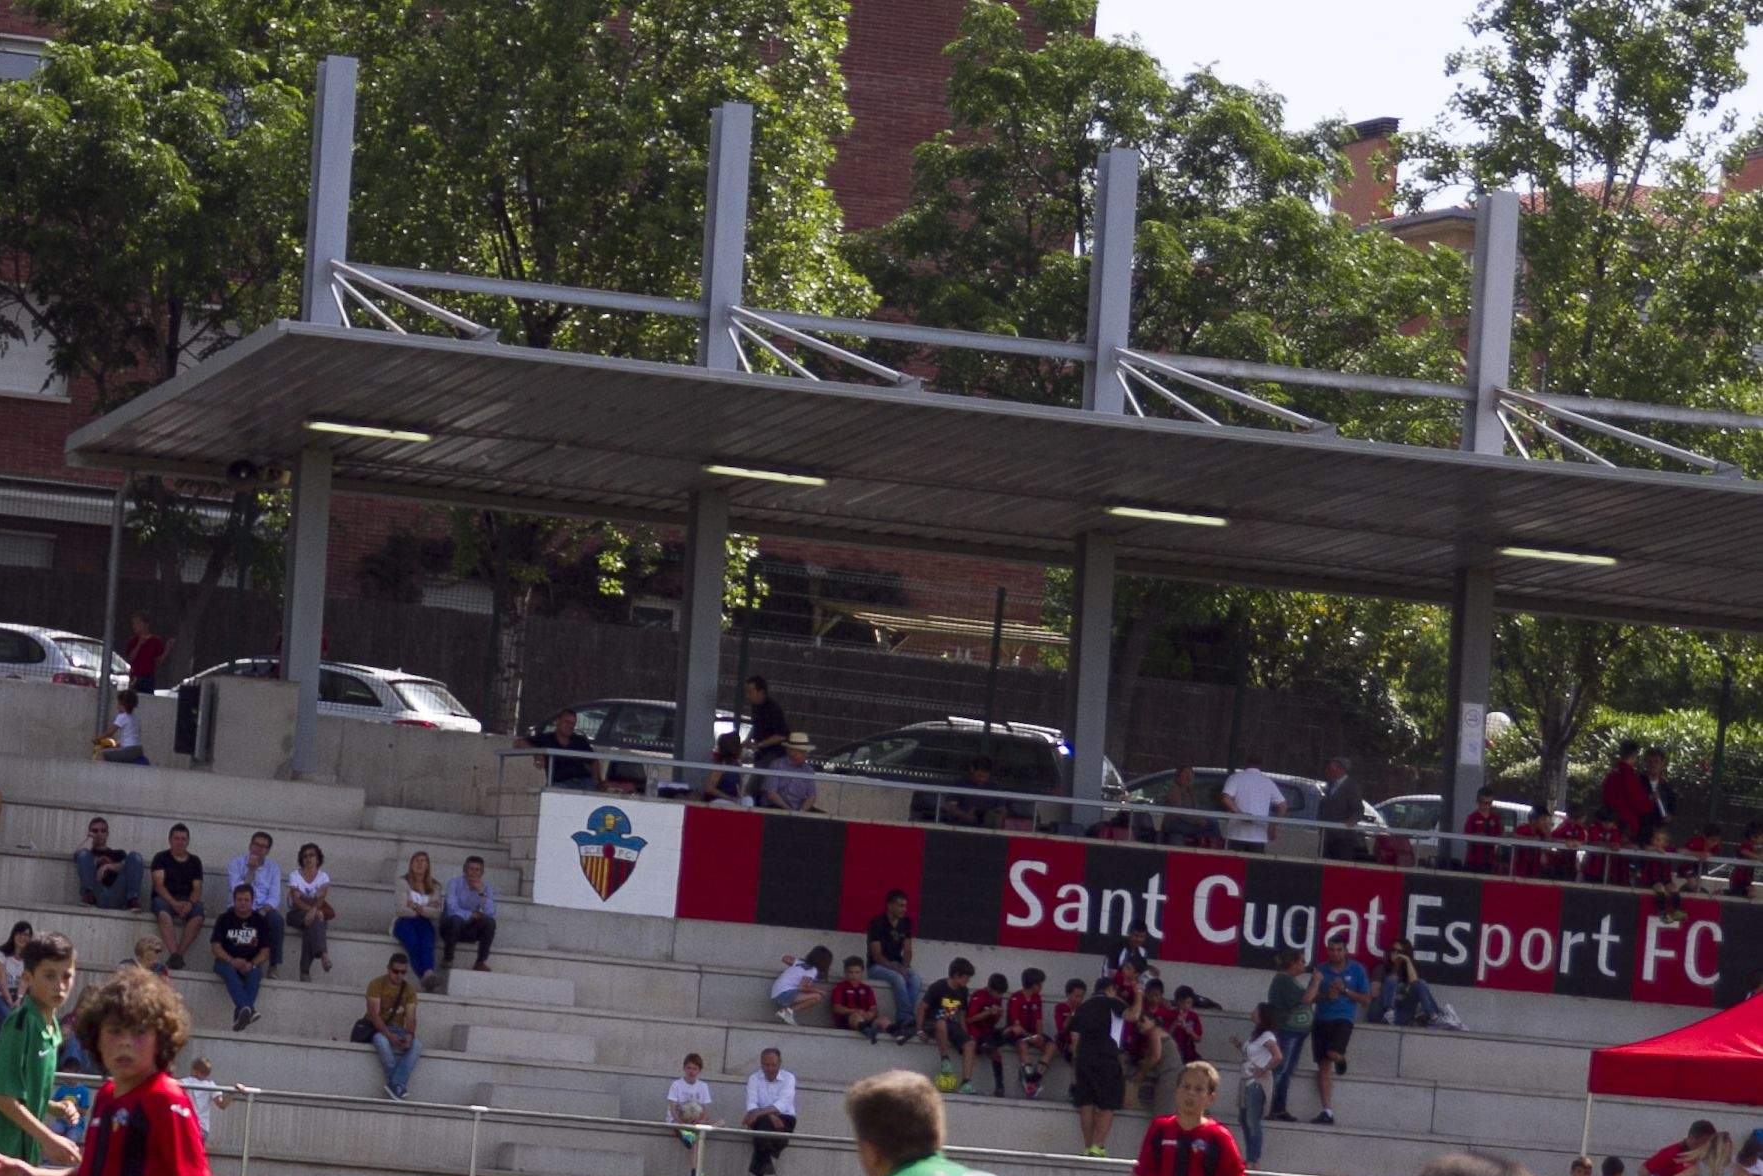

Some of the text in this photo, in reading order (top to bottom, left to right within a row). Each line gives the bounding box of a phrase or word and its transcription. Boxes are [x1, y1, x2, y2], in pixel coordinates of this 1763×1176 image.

[1006, 859, 1723, 986] Sant Cugat Esport FC
